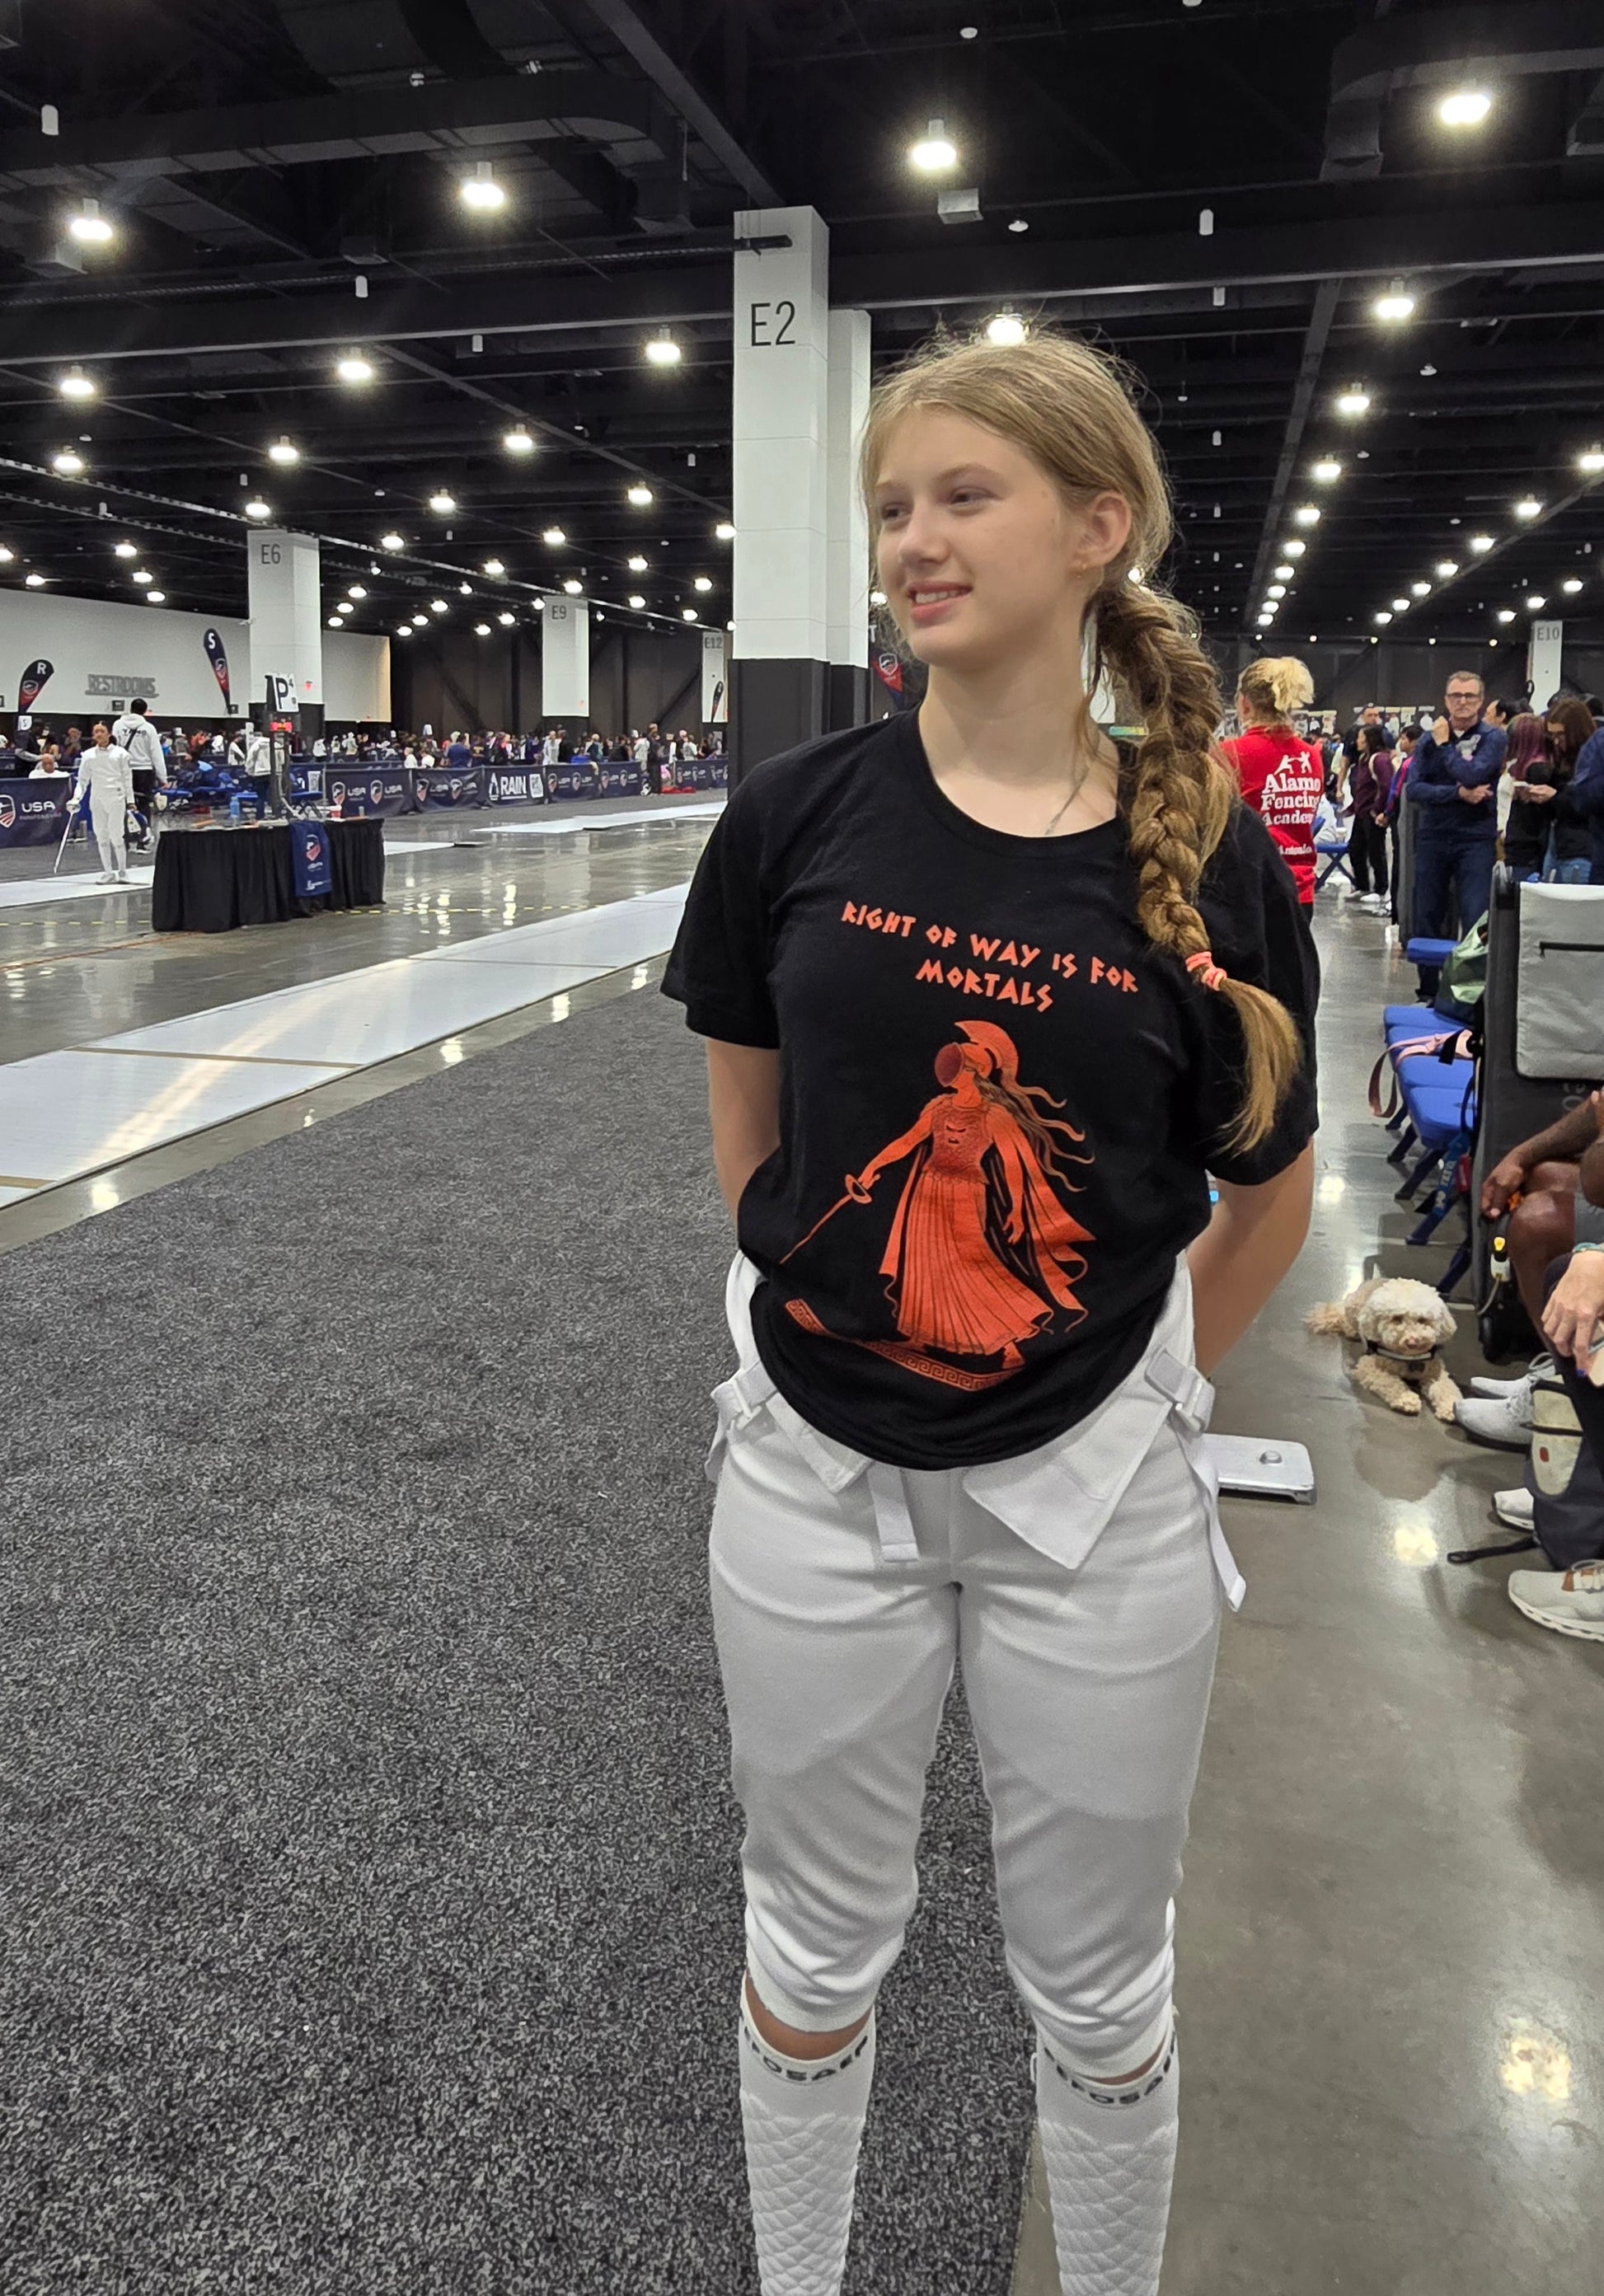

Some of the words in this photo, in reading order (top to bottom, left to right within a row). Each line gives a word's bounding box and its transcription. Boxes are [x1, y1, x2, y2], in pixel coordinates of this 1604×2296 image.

[751, 300, 796, 347] E2
[260, 543, 281, 565] E6
[551, 604, 567, 620] E9
[208, 632, 216, 649] S
[704, 636, 723, 649] E12
[1536, 627, 1560, 640] E10
[36, 662, 47, 675] R
[275, 677, 289, 710] P
[500, 775, 527, 795] RAIN
[1262, 773, 1321, 794] Alamo
[21, 800, 56, 813] USA
[841, 901, 917, 937] RIGHT
[926, 925, 958, 948] OF
[970, 934, 1040, 968] WAY
[1052, 953, 1078, 979] IS
[1090, 956, 1139, 993] FOR
[915, 958, 1053, 1013] MORTALS
